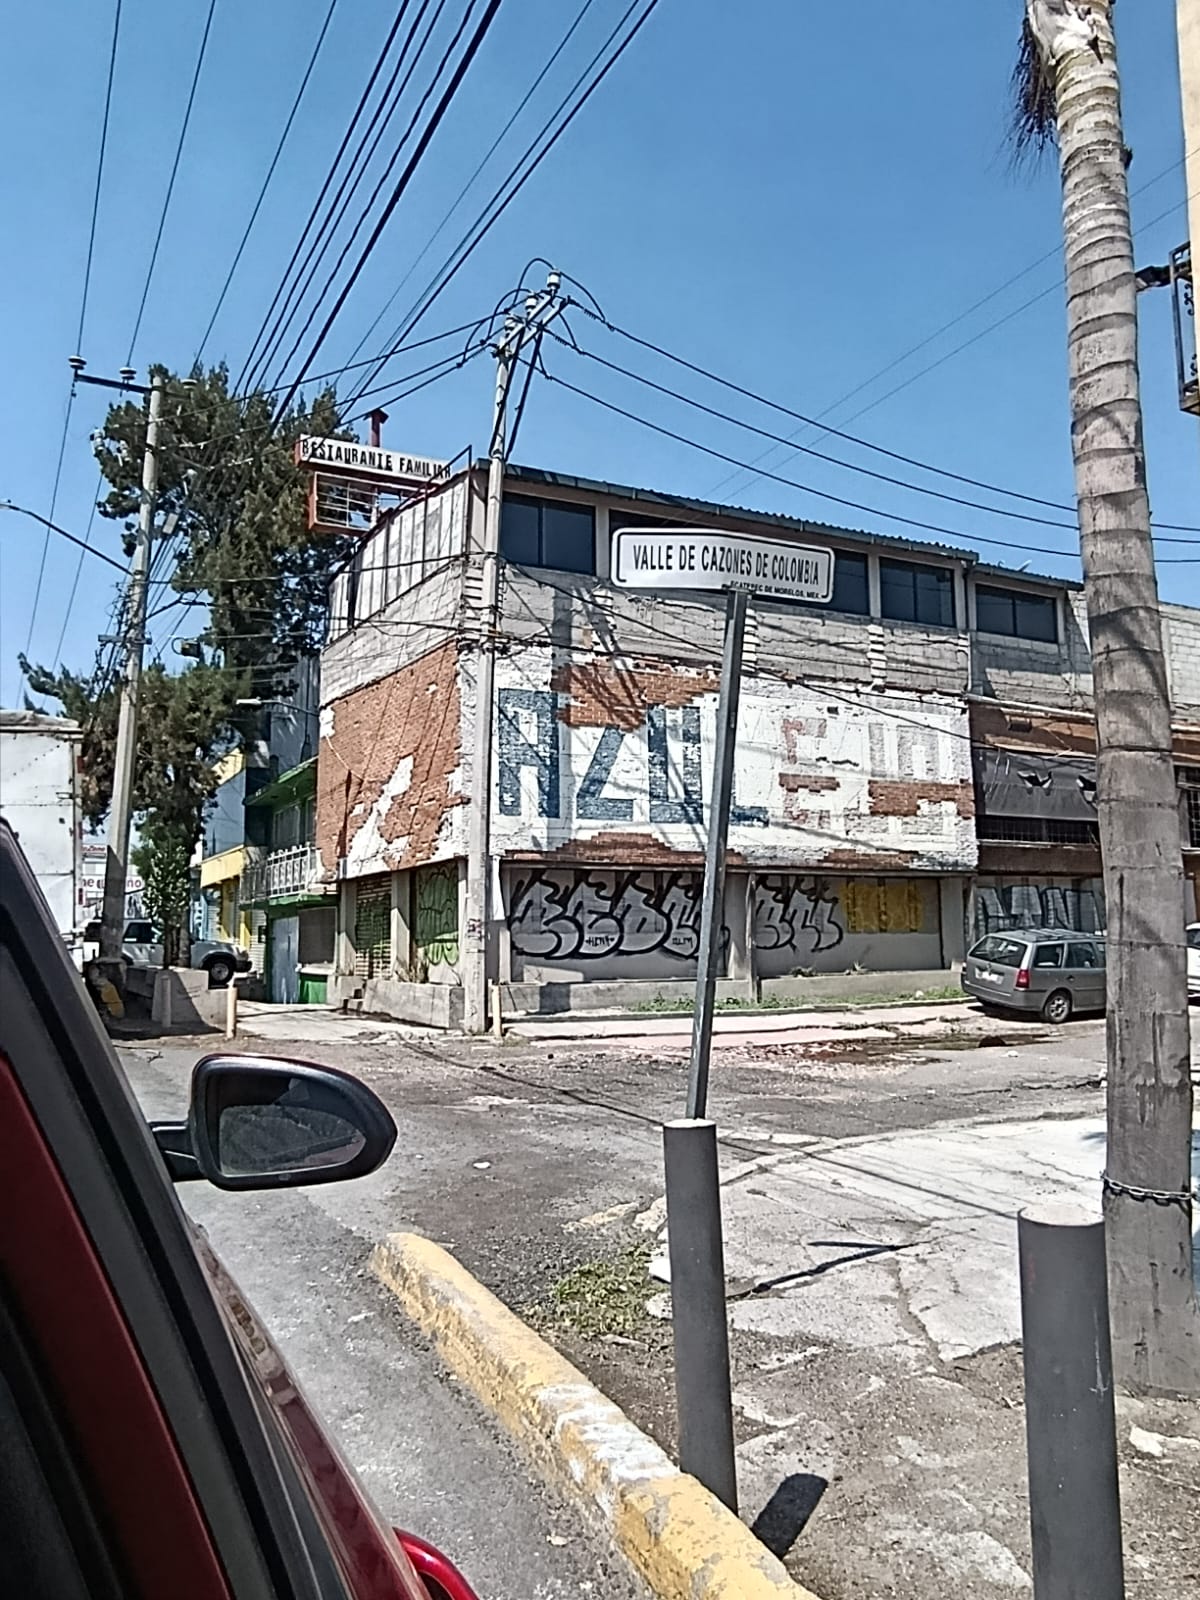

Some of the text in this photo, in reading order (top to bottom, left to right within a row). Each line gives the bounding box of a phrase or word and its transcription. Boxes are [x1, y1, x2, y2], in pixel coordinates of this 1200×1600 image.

[302, 439, 393, 472] RESTAURANTE
[633, 544, 819, 585] VALLE DE CAZONES DE COLOMBIA
